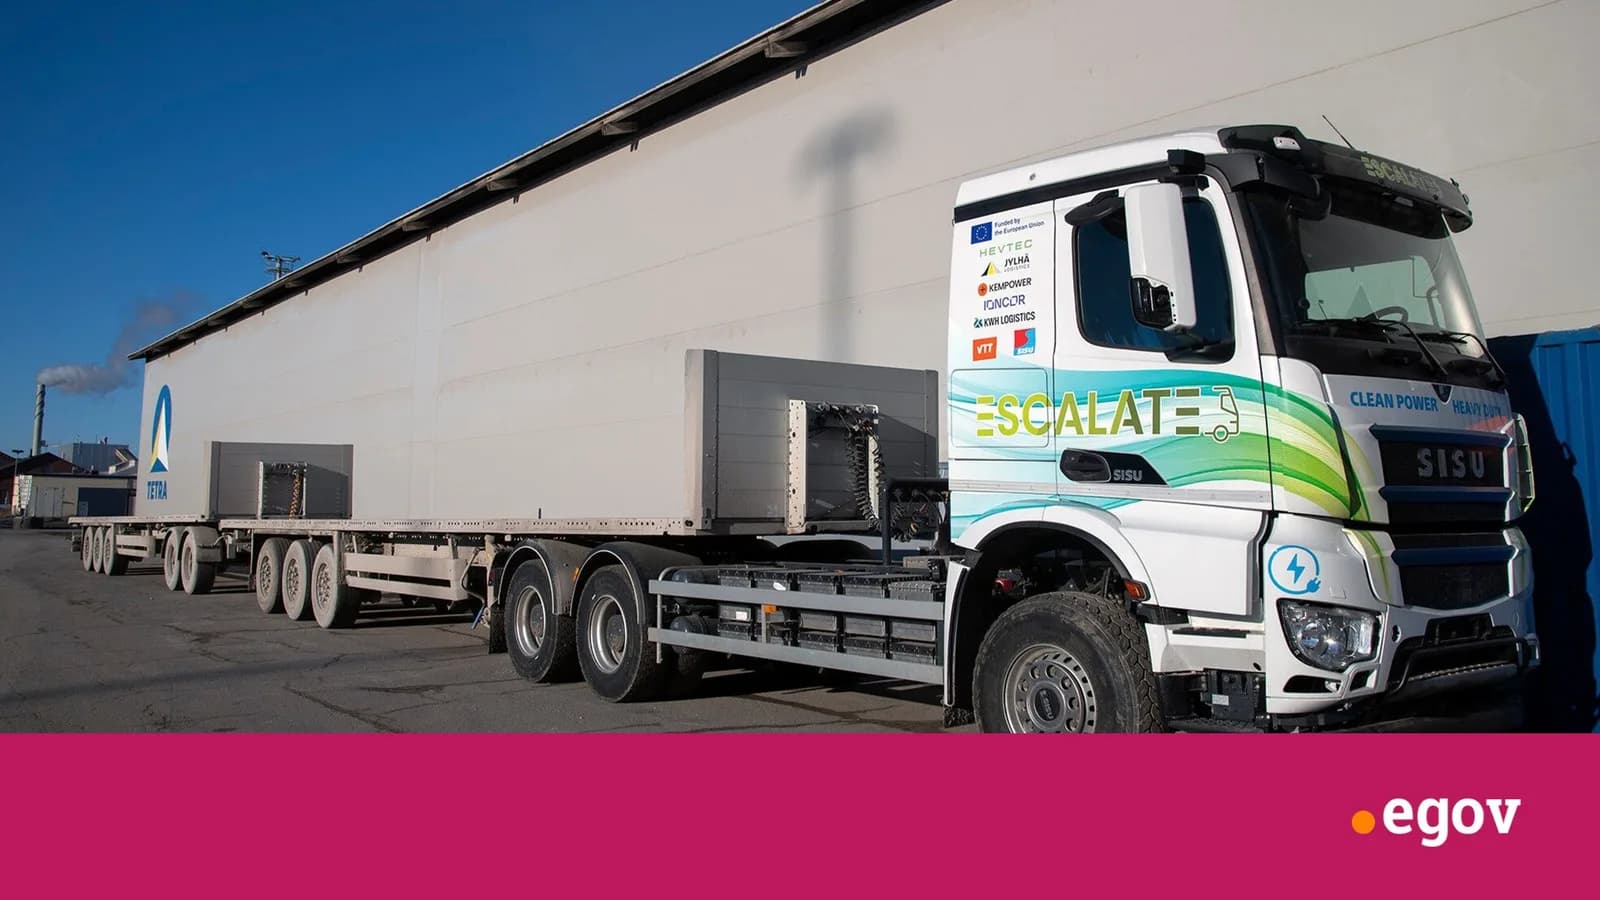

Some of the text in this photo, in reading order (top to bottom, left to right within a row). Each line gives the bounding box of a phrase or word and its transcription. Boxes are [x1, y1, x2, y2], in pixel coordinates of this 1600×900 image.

[994, 219, 1013, 228] Funded
[1003, 224, 1028, 234] European
[1028, 220, 1045, 228] Union
[979, 239, 1033, 257] HEVTEC
[989, 277, 1032, 292] KEMPOWER
[983, 294, 1026, 311] IONCOR
[984, 311, 1036, 328] KWH LOGISTICS
[977, 343, 994, 354] VTT
[1350, 391, 1394, 409] CLEAN
[1396, 394, 1439, 412] POWER
[1453, 399, 1481, 415] HEAVY
[977, 388, 1199, 436] ESCALATE
[1417, 447, 1485, 479] SISU
[1113, 469, 1142, 482] SISU
[147, 480, 168, 500] TETRA
